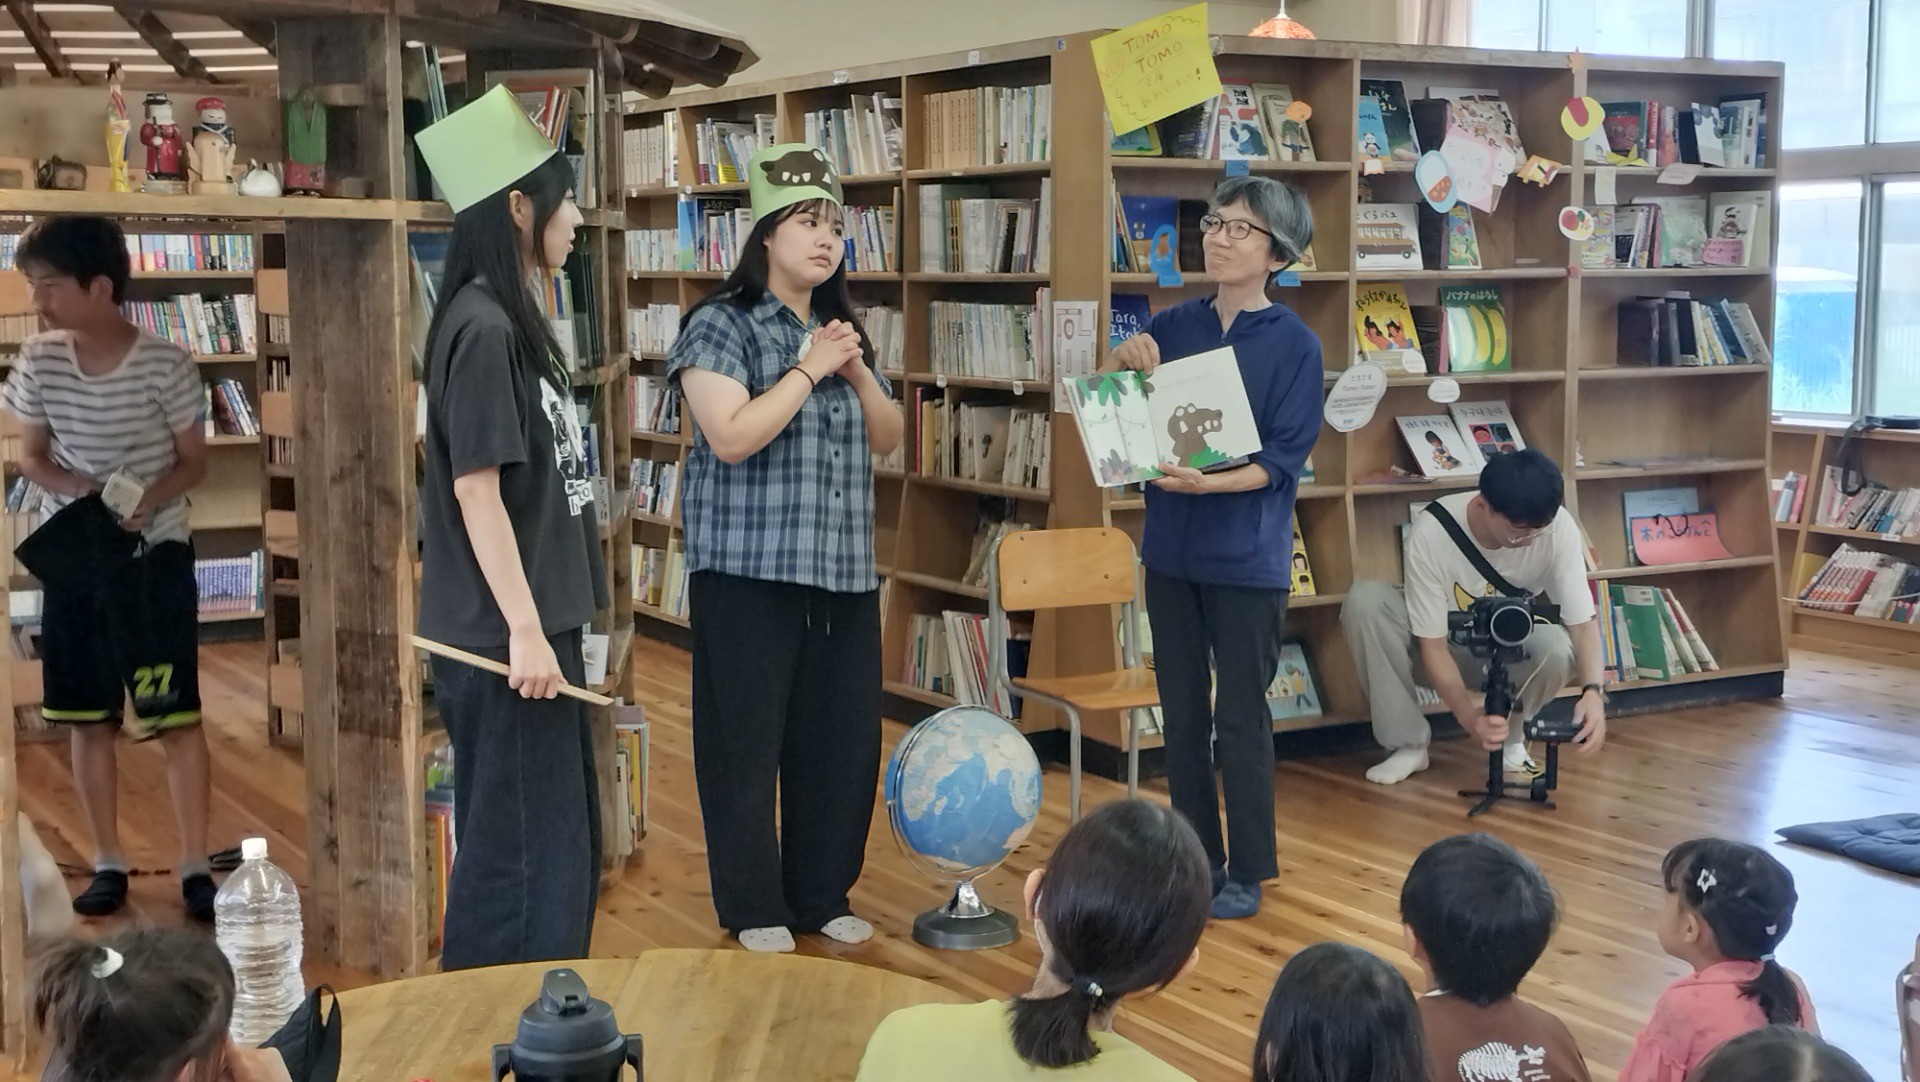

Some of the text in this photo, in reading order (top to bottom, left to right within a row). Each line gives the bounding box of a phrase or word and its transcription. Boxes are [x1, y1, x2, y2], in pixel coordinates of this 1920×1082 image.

[1122, 23, 1172, 54] TOMO
[1135, 41, 1182, 73] TOMO
[1446, 289, 1499, 301] バナナのはなし
[133, 663, 174, 699] 27
